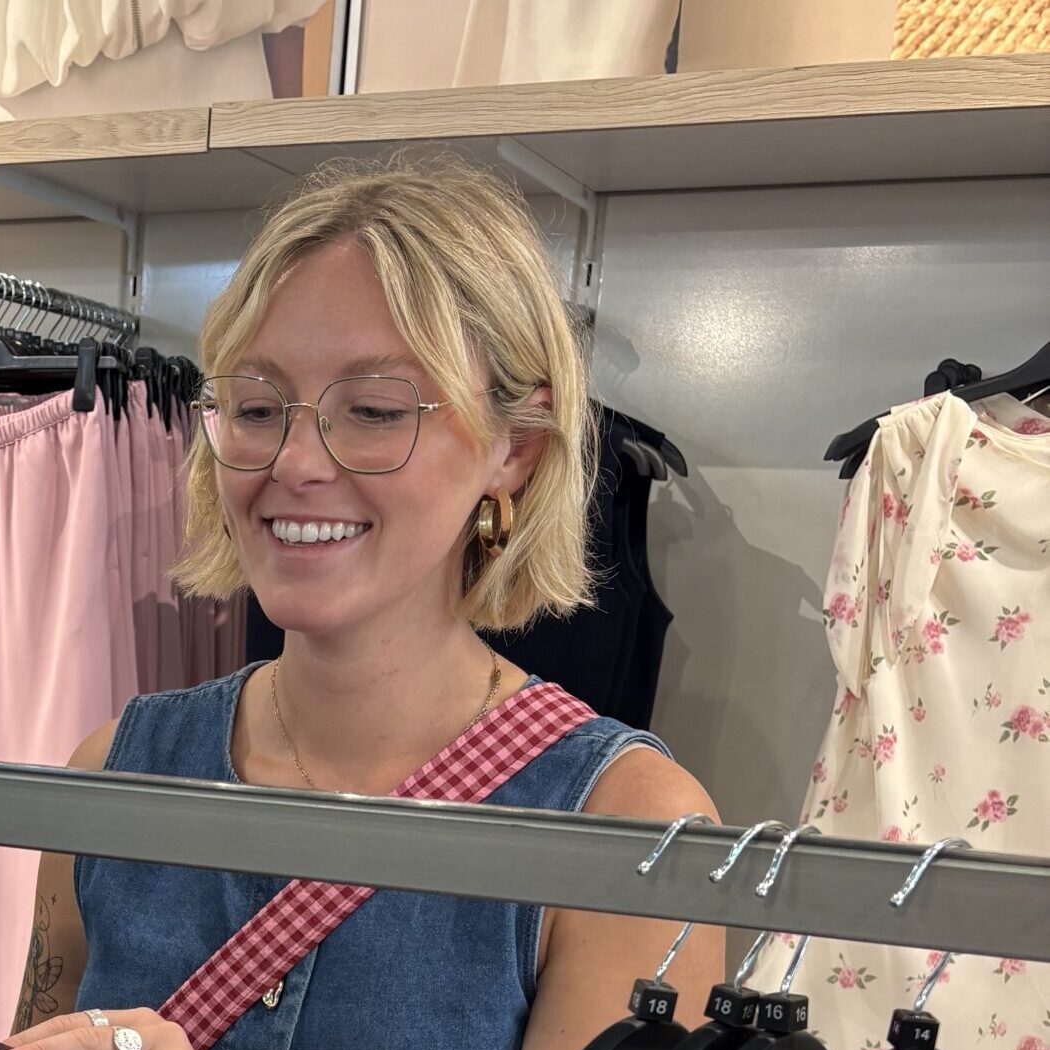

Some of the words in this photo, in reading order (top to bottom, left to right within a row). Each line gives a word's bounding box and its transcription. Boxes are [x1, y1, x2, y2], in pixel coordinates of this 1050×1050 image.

[648, 998, 668, 1015] 18
[714, 996, 733, 1015] 18
[765, 1003, 784, 1020] 16
[796, 1006, 807, 1023] 16
[915, 1028, 930, 1041] 14
